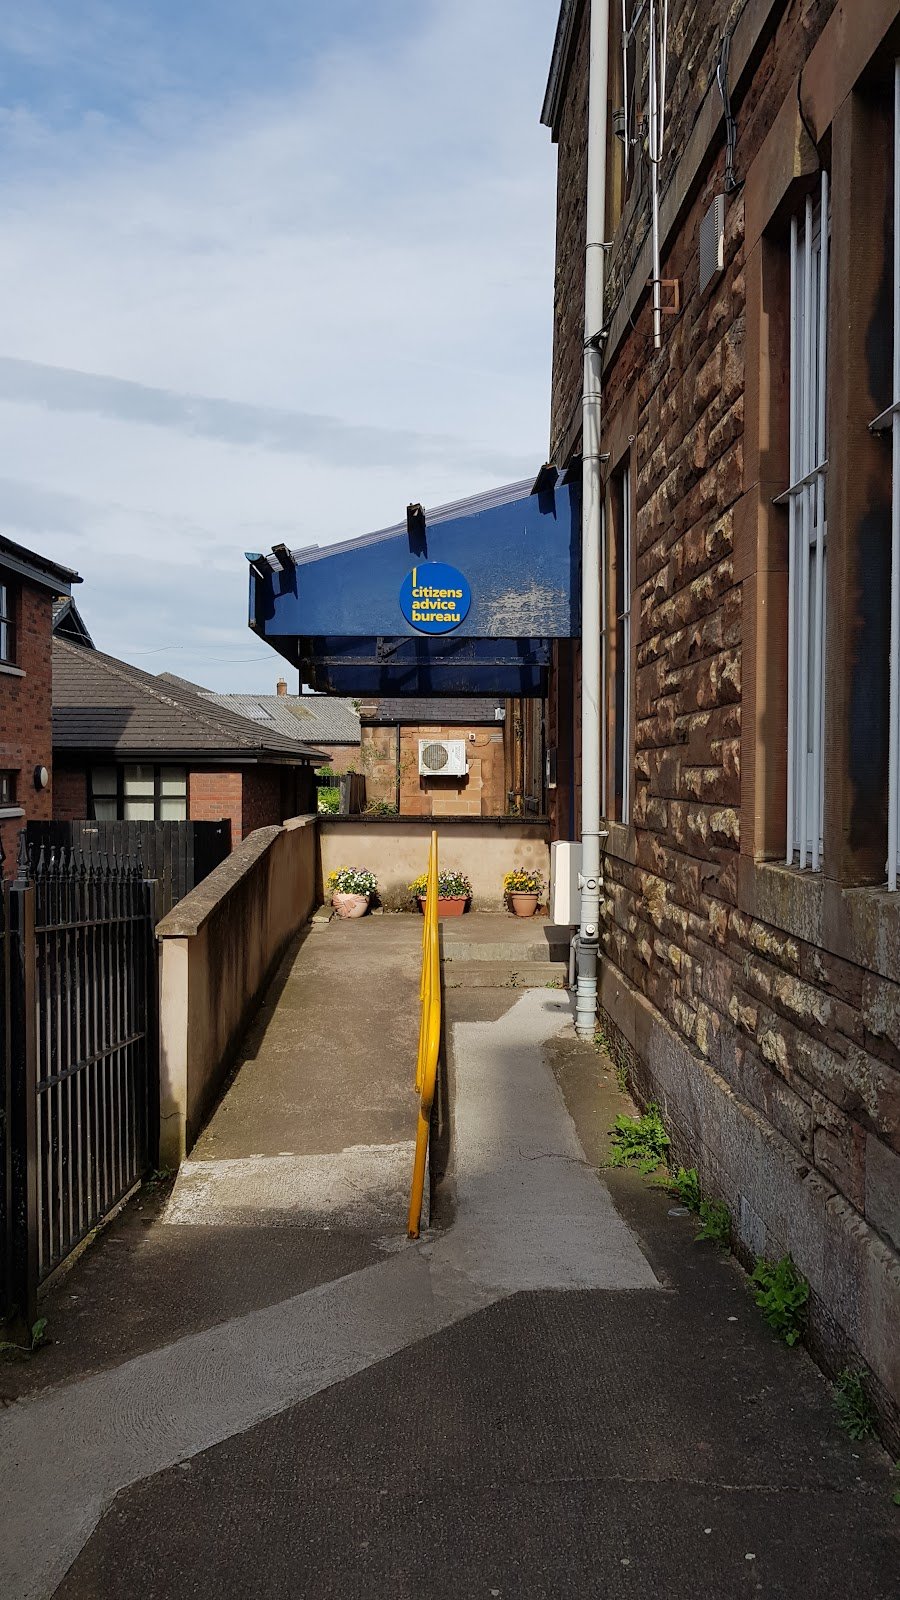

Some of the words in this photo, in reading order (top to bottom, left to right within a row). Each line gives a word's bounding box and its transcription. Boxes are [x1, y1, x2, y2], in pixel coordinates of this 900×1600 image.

[412, 586, 463, 598] citizens
[412, 598, 456, 610] advice
[411, 610, 461, 622] bureau
